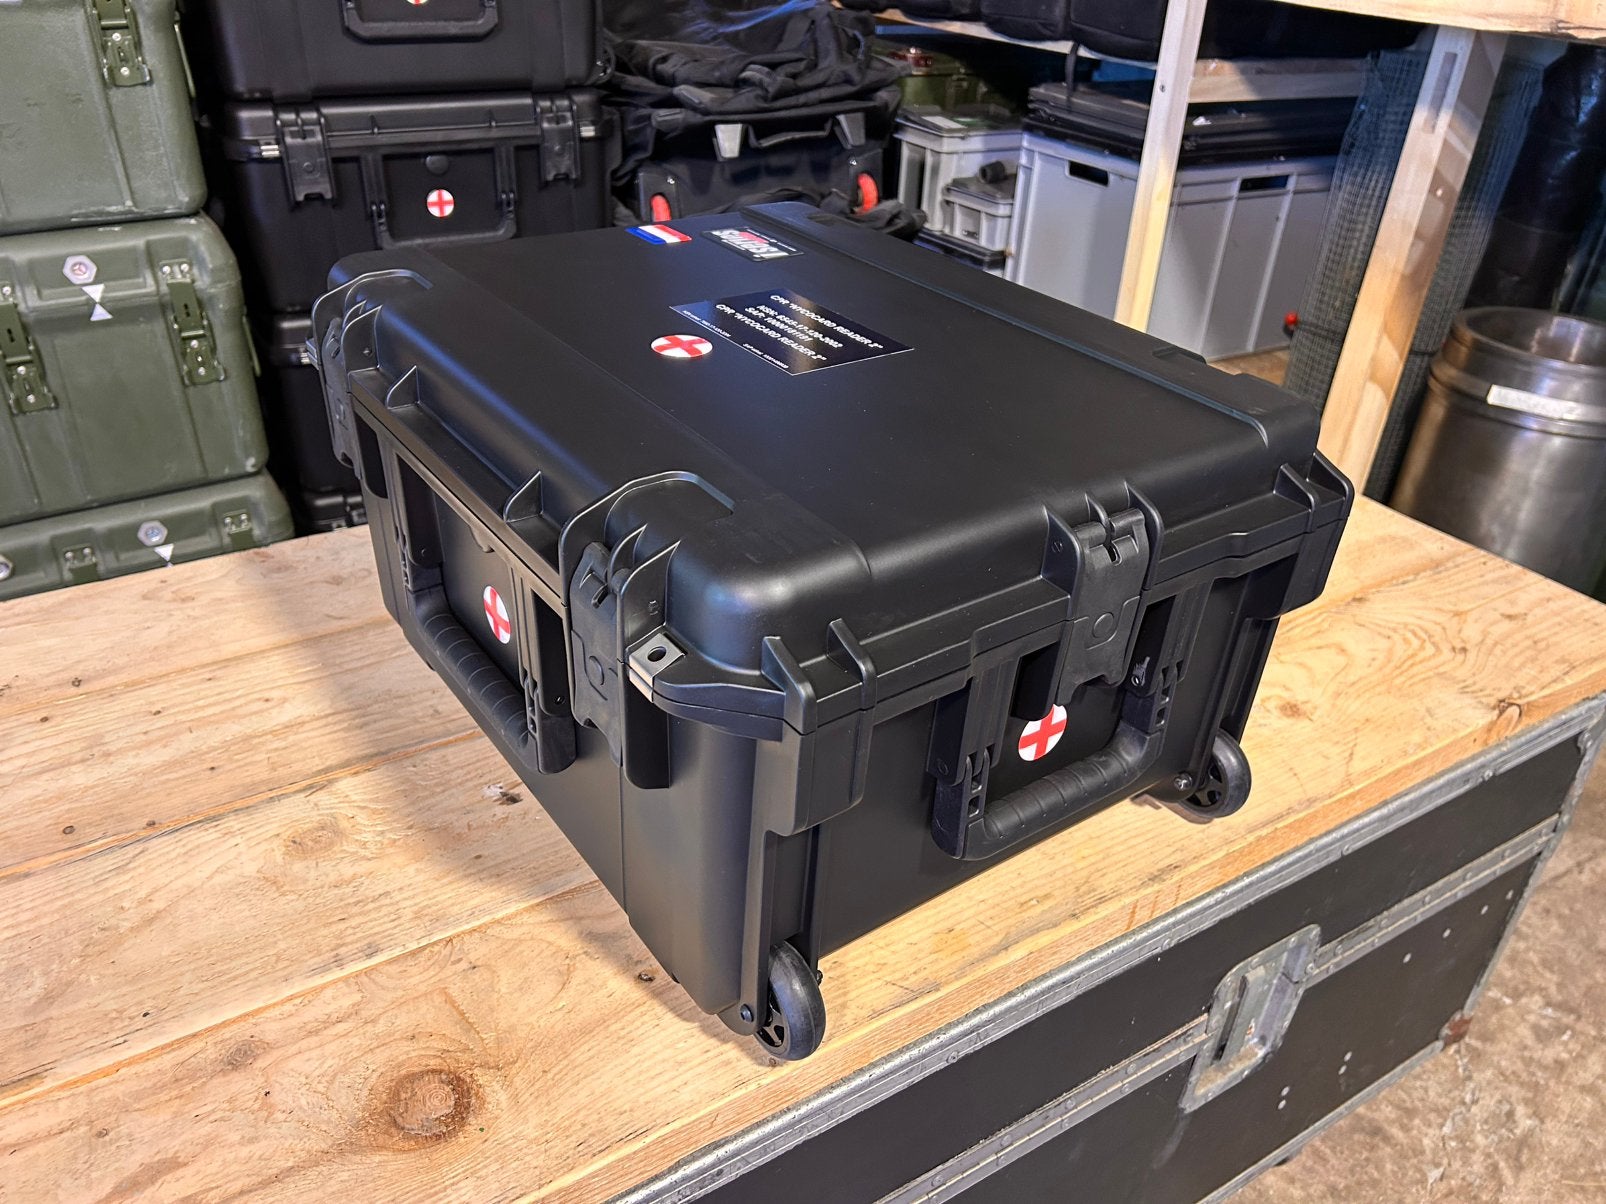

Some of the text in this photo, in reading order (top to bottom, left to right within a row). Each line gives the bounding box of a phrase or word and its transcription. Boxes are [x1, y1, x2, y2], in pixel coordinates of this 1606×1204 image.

[716, 304, 735, 314] CPR
[778, 337, 816, 356] READER
[770, 295, 789, 304] CPR
[834, 326, 872, 345] READER
